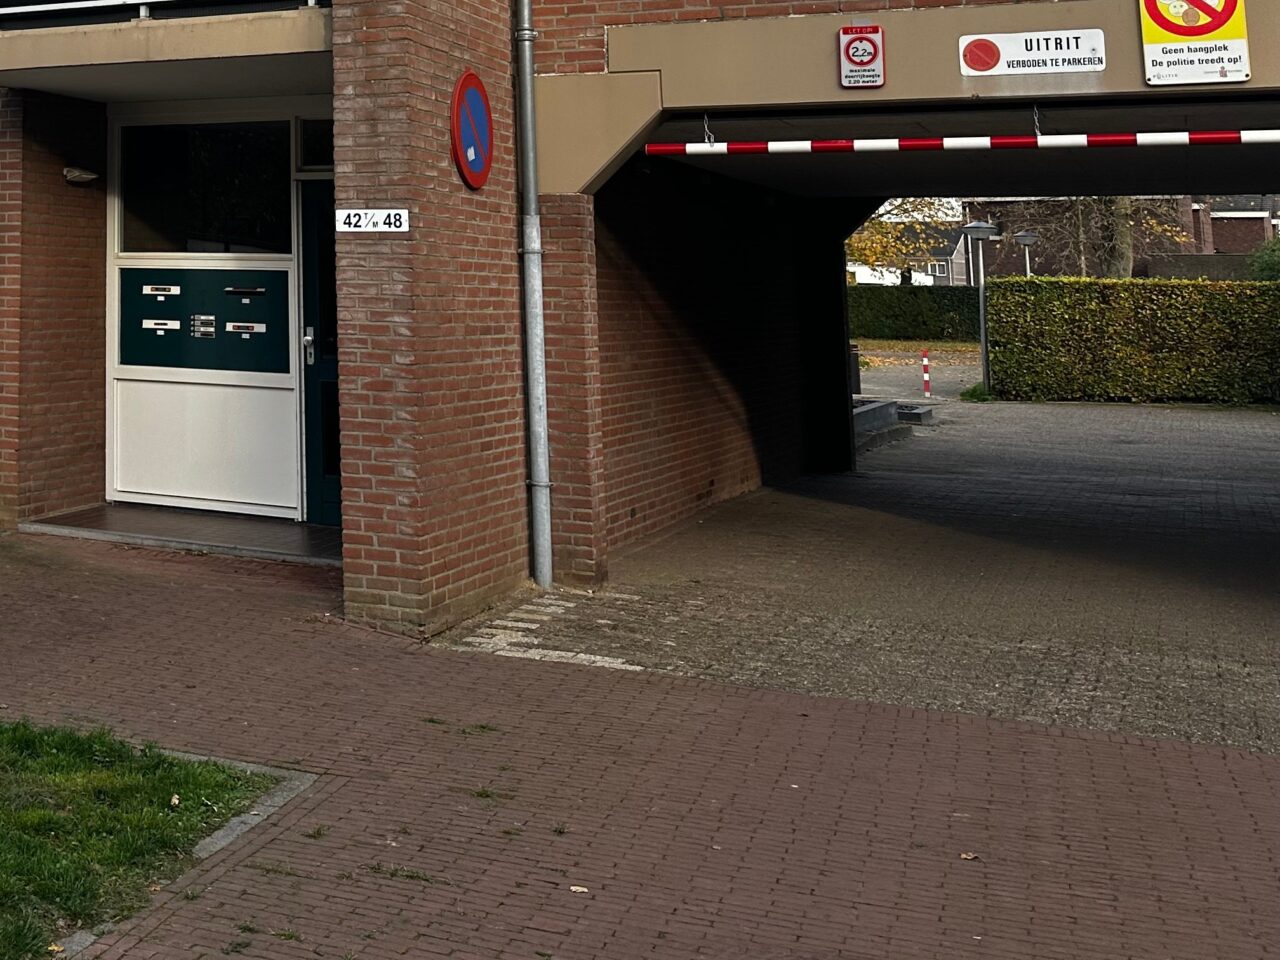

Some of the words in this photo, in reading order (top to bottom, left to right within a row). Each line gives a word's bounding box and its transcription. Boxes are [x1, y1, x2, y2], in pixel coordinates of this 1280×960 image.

[1024, 36, 1081, 52] UITRIT
[1161, 46, 1185, 55] Geen
[1187, 43, 1229, 54] hangplek
[1006, 58, 1048, 69] VERBODEN
[1049, 58, 1060, 67] TE
[1061, 56, 1104, 67] PARKEREN
[1151, 59, 1164, 67] De
[1166, 57, 1195, 68] politie
[1197, 56, 1225, 65] treedt
[1227, 55, 1242, 65] op!
[343, 212, 362, 228] 42
[382, 212, 403, 229] 48
